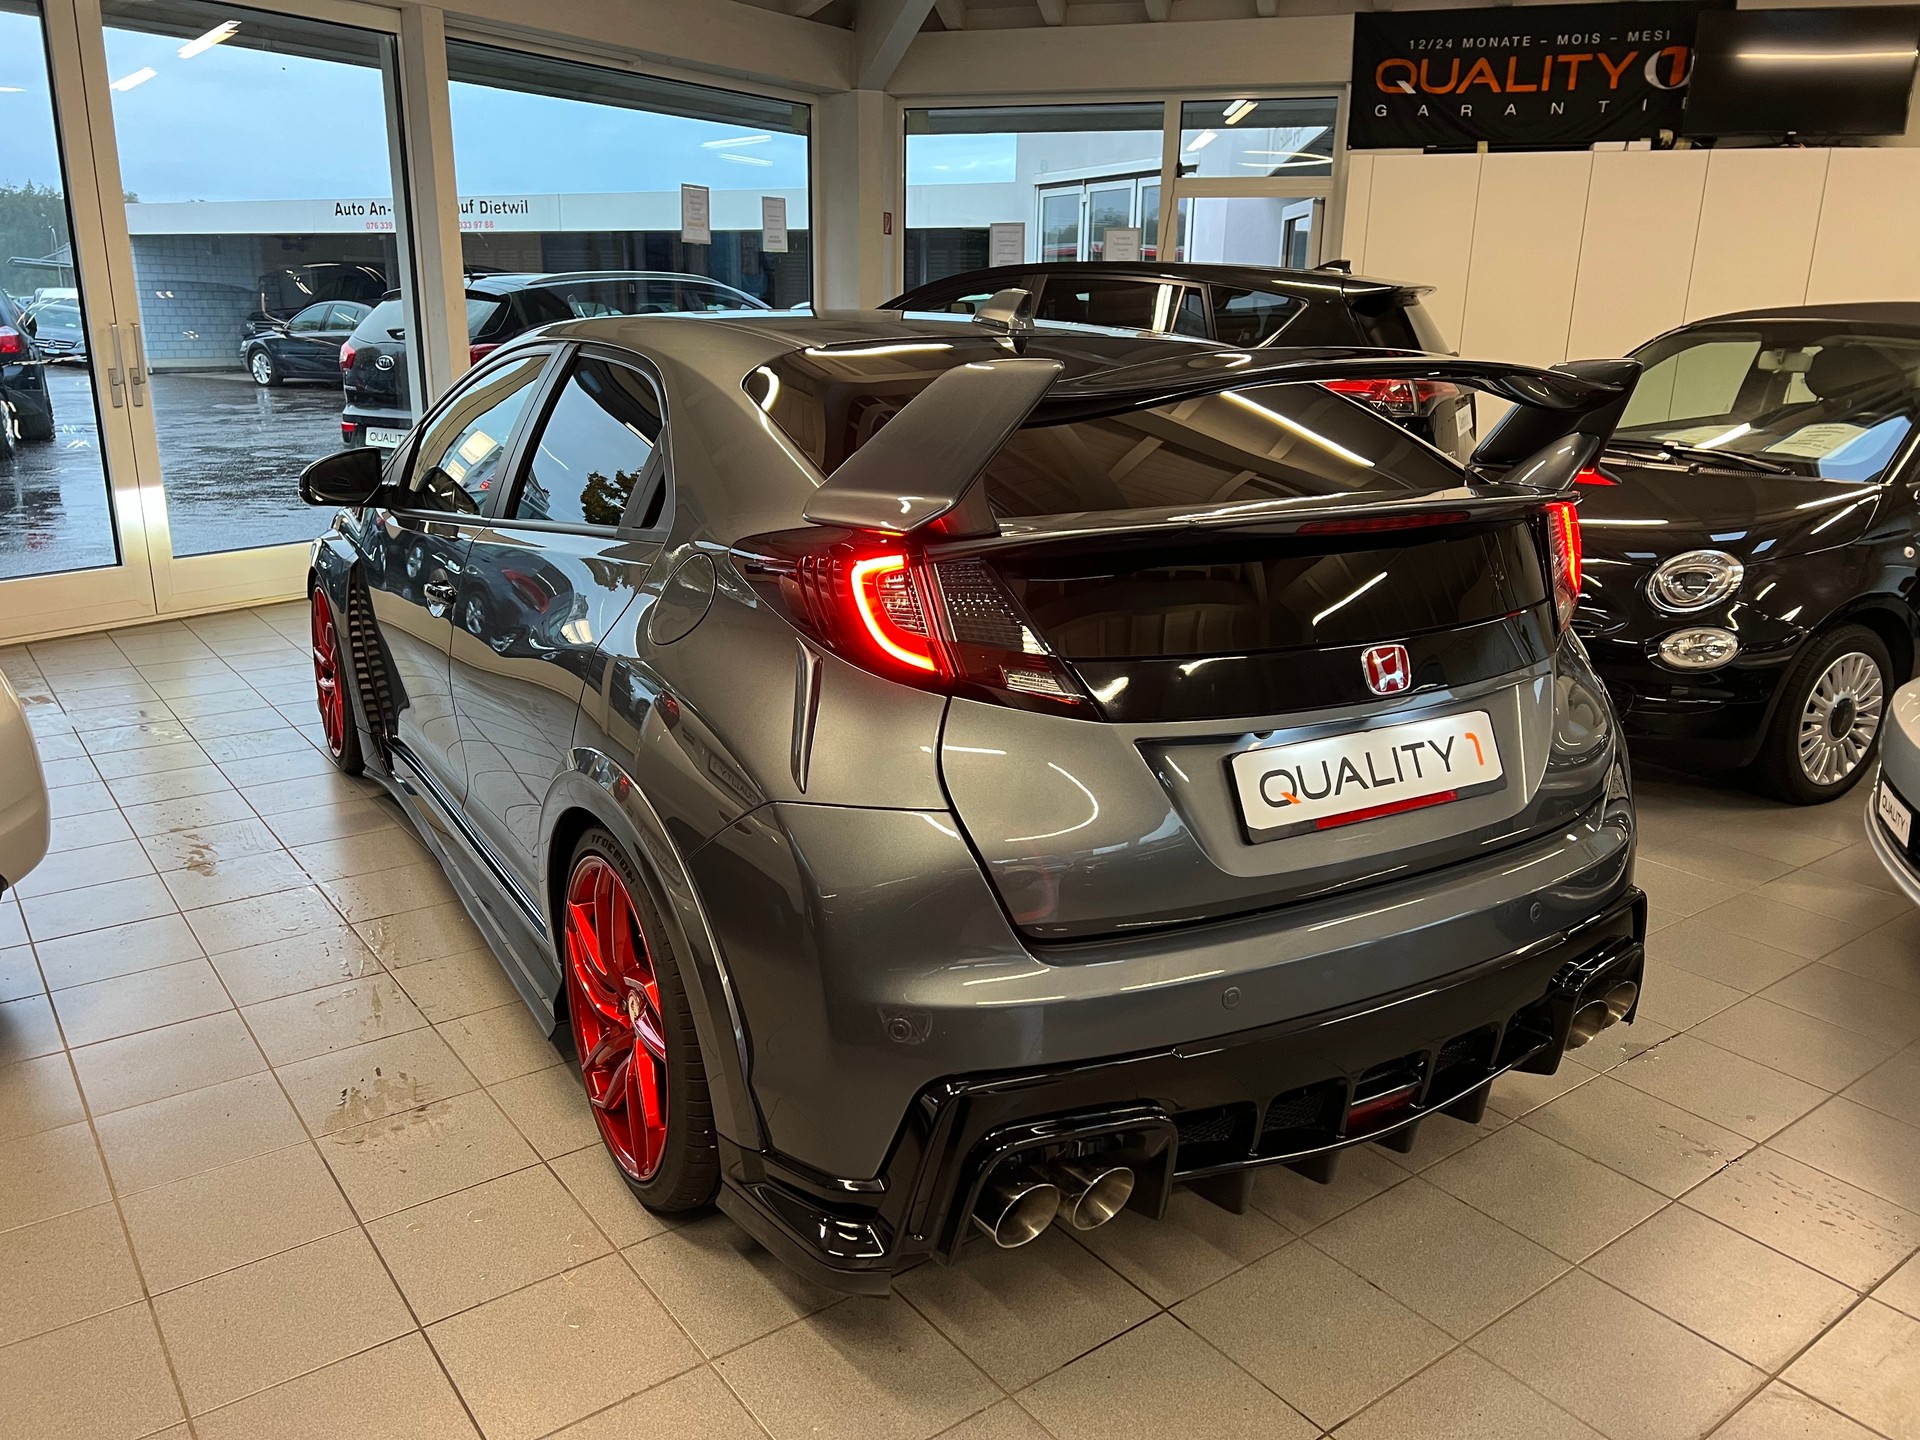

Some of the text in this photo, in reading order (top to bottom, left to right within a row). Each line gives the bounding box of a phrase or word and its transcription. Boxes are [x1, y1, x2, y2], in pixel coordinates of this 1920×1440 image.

[1409, 38, 1453, 50] 12/24
[1462, 35, 1532, 49] MONATE
[1556, 32, 1601, 46] MOIS
[1626, 29, 1671, 43] MESI
[1375, 50, 1639, 95] QUALITY
[1374, 96, 1687, 118] GARANTI
[334, 202, 365, 216] Auto
[369, 201, 392, 216] An-
[479, 199, 529, 215] Dietwil
[365, 221, 379, 230] 076
[380, 221, 393, 230] 339
[473, 220, 484, 229] 97
[484, 220, 495, 229] 88
[369, 432, 406, 445] QUALIT
[1259, 732, 1485, 808] QUALITY 1
[1882, 795, 1906, 832] QUALITY
